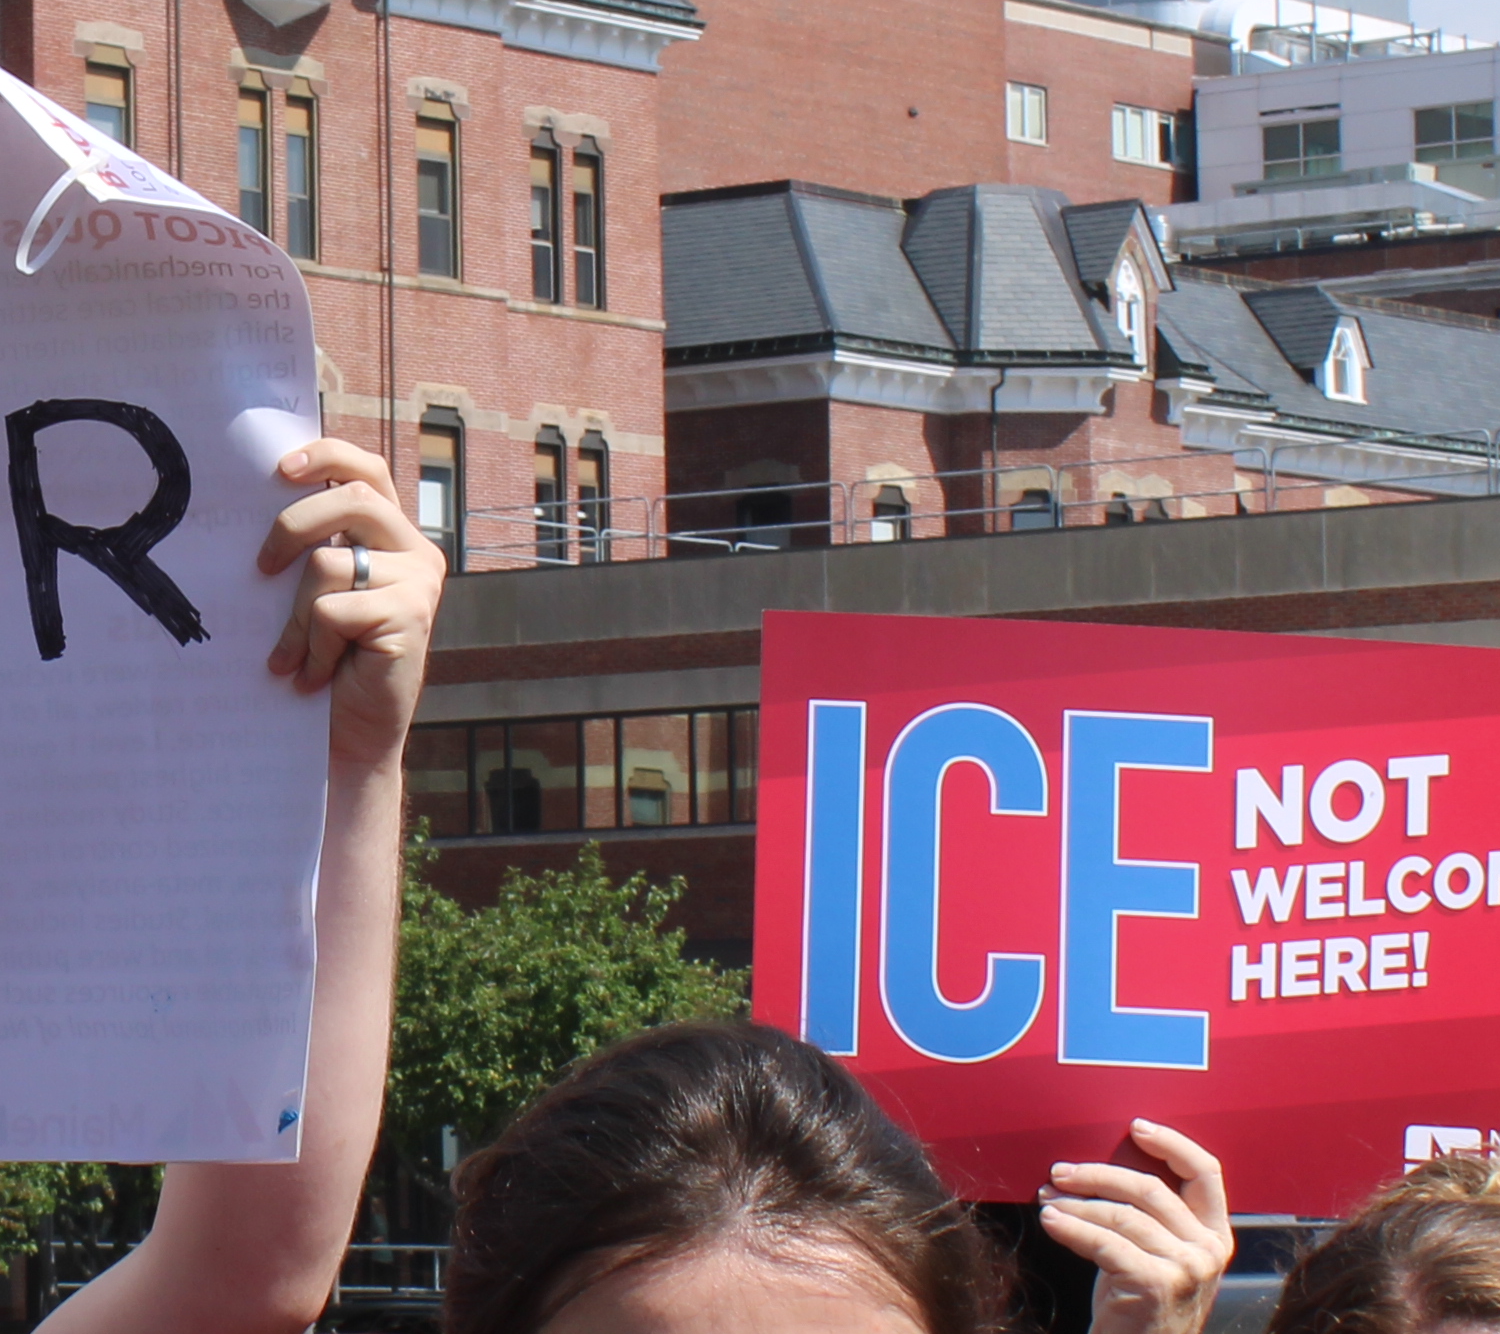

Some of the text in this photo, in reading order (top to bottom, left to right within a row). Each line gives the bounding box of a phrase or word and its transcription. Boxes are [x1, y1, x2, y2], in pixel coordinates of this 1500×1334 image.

[1235, 754, 1450, 851] NOT
[800, 698, 1214, 1071] ICE
[1231, 931, 1429, 1002] HERE!
